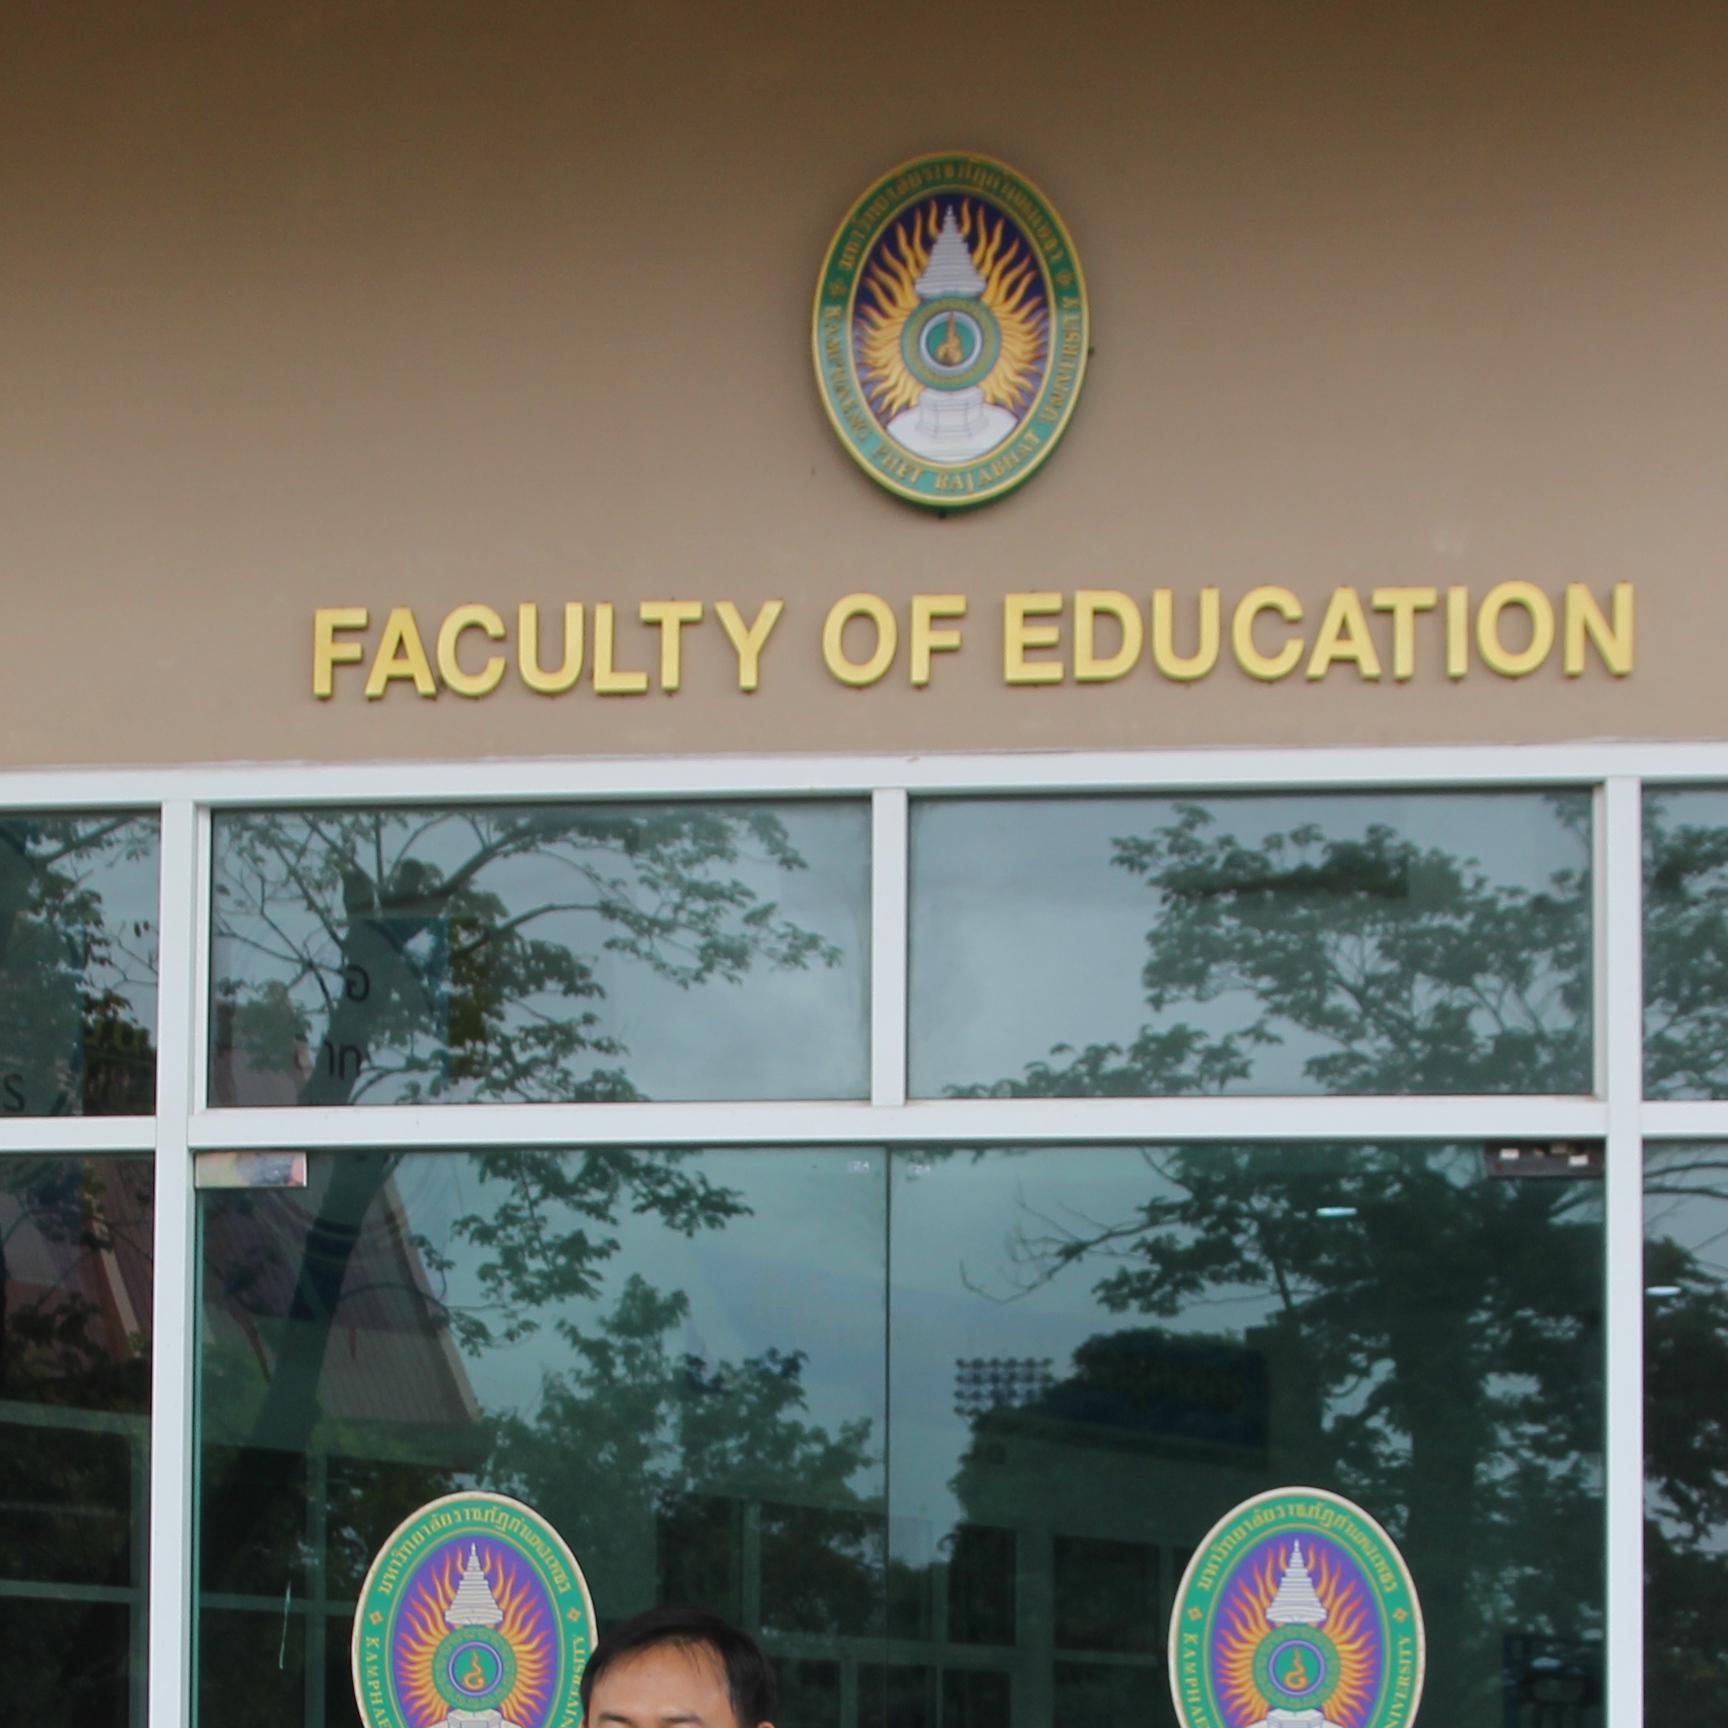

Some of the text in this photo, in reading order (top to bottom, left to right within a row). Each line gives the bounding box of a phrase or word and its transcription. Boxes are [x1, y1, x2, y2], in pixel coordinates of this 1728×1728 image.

[312, 580, 1634, 699] FACULTY OF EDUCATION
